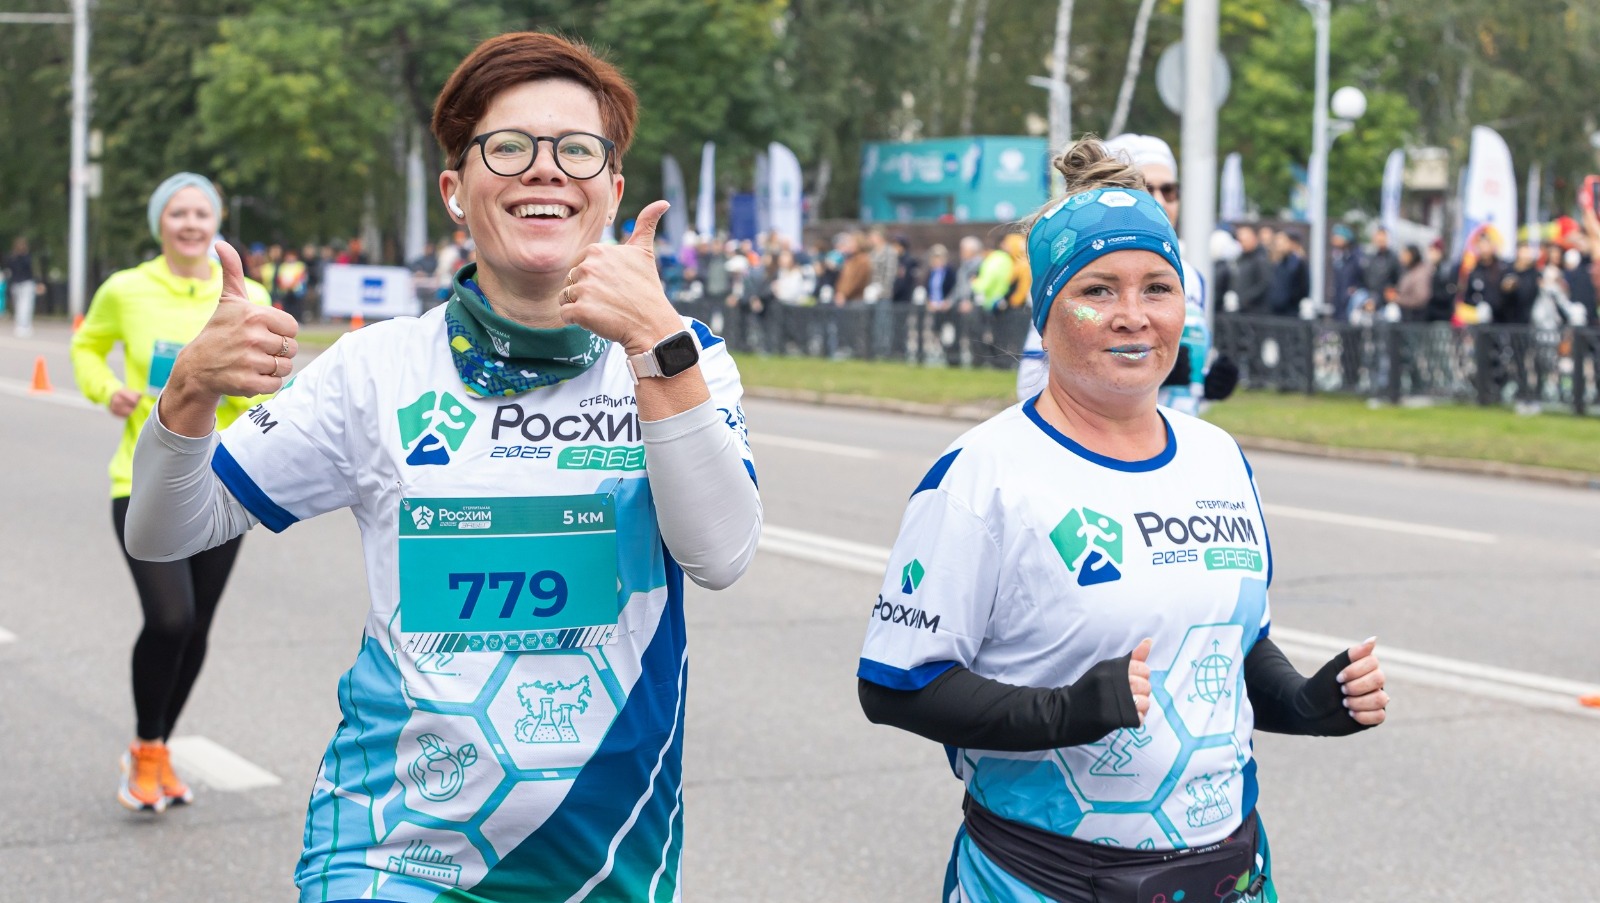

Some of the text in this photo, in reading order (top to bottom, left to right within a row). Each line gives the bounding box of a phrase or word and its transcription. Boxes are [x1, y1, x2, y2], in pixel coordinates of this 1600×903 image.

[579, 394, 637, 408] СТЕРЛИТА
[489, 445, 553, 459] 2025
[562, 510, 574, 525] 5
[1152, 549, 1198, 565] 2025
[448, 570, 568, 620] 779
